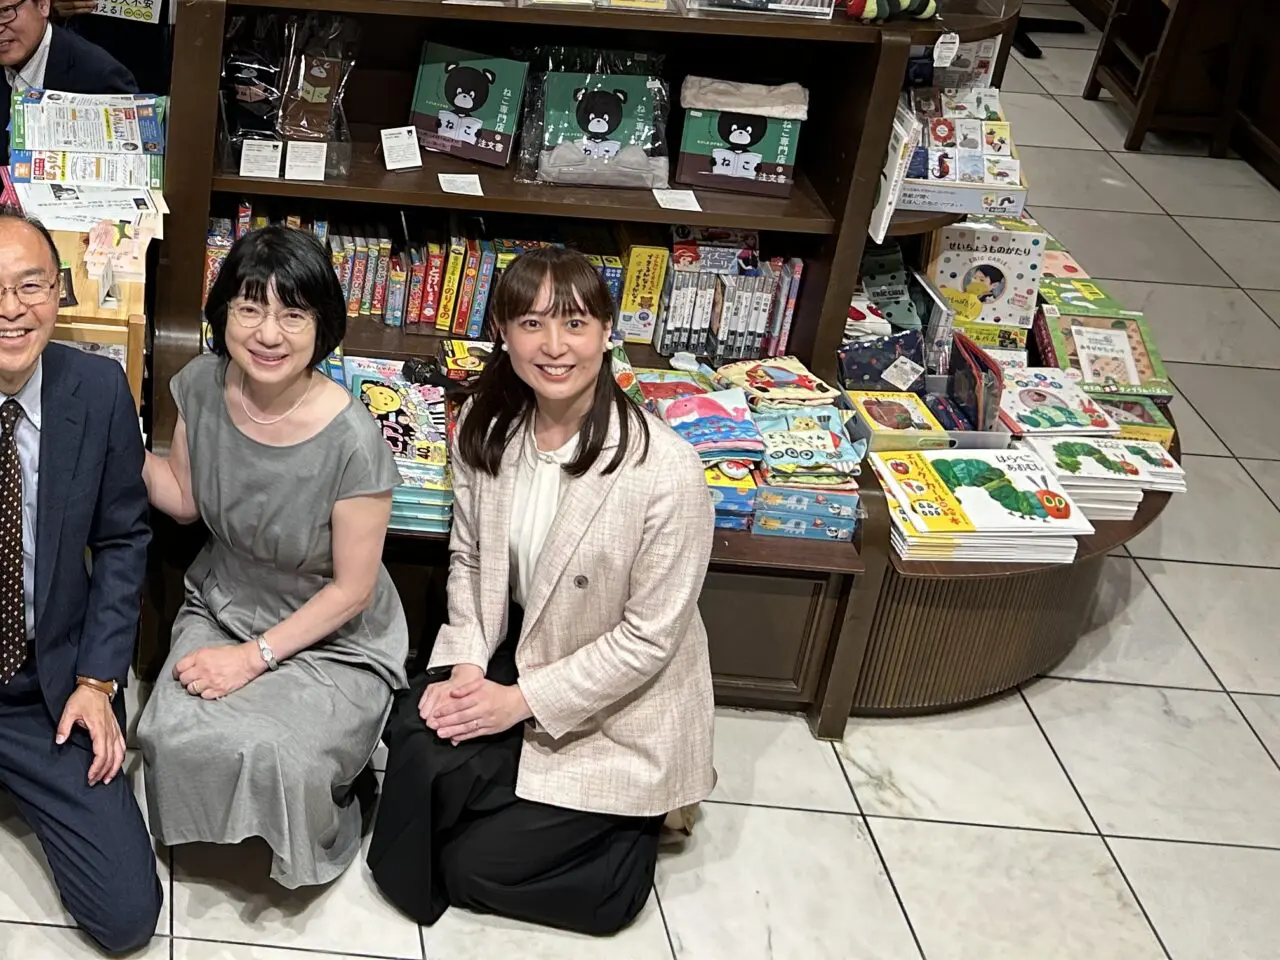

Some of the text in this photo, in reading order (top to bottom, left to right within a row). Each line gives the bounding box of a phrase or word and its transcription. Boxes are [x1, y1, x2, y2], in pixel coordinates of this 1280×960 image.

[494, 87, 512, 133] ねこ専門店
[445, 119, 472, 135] ね こ
[477, 139, 504, 153] 注文書
[721, 156, 750, 171] ね こ
[949, 241, 1031, 256] せいちょうものがたり
[968, 255, 1009, 268] ERIC CARLE
[995, 454, 1033, 463] はらぺこ
[1006, 463, 1045, 472] あおむし
